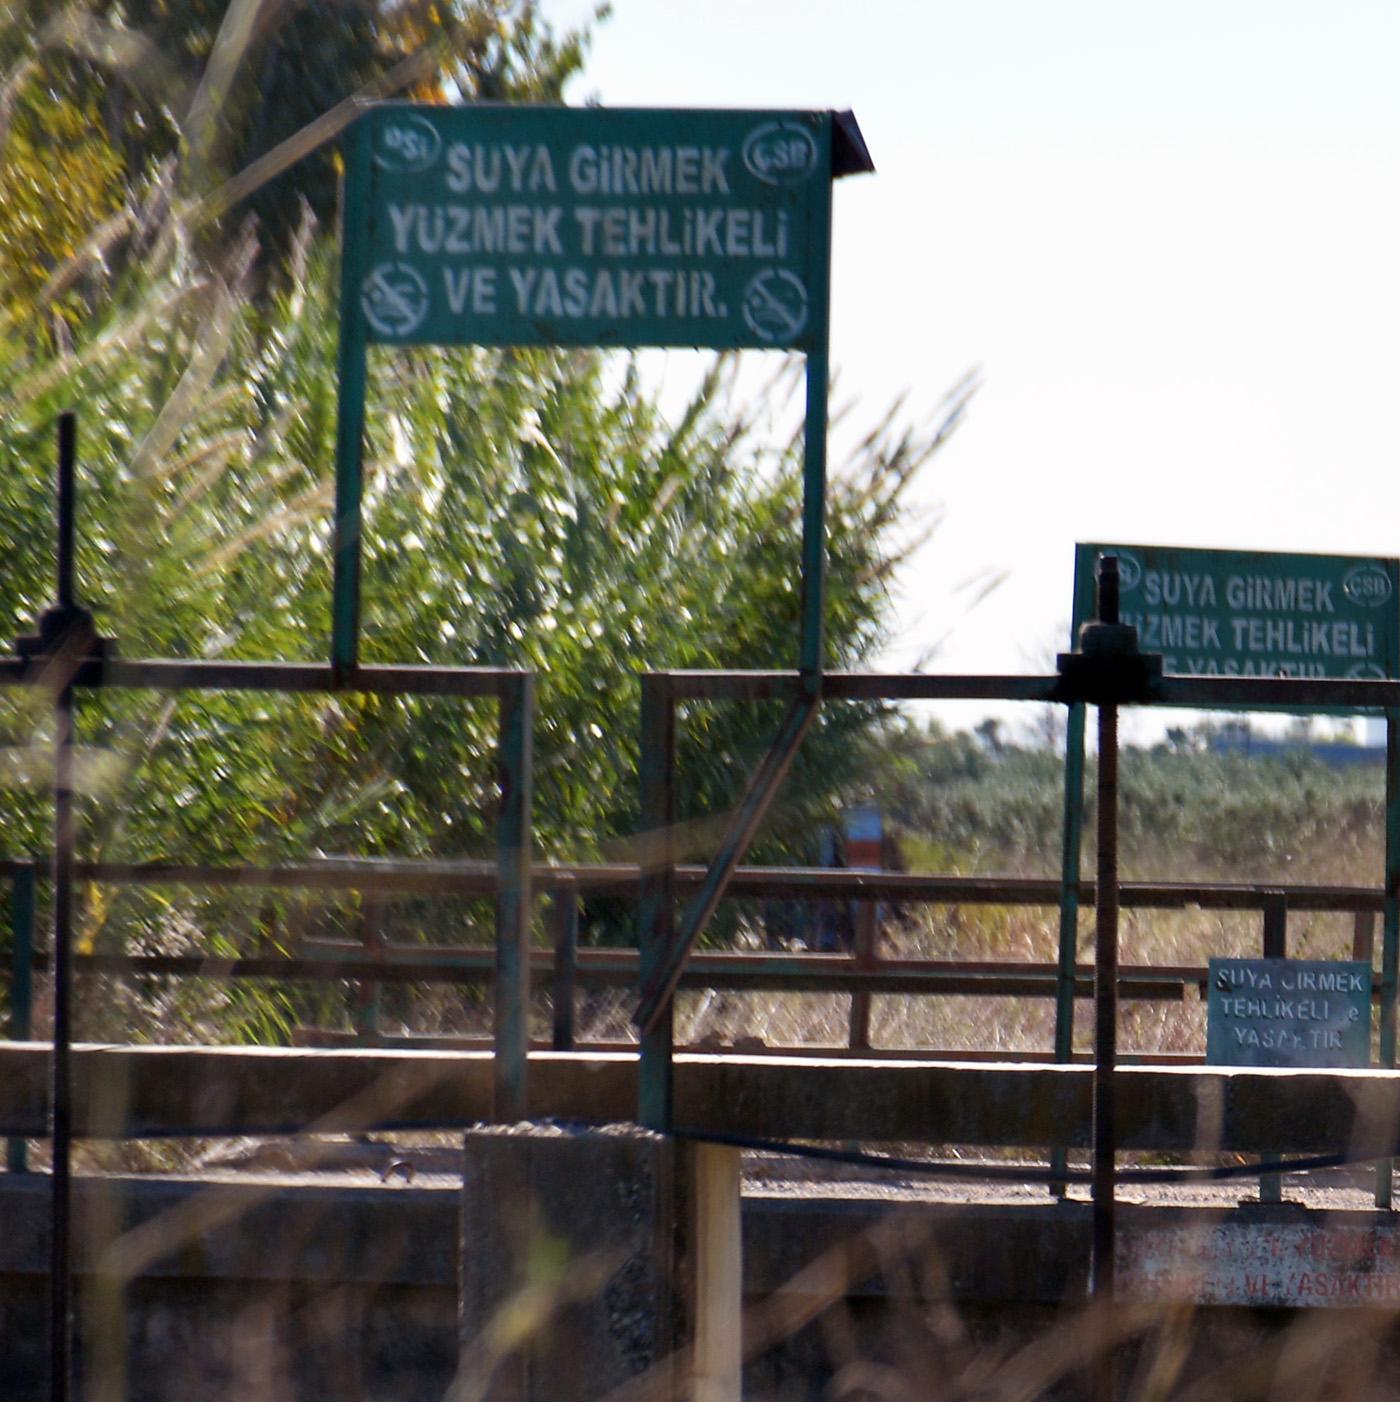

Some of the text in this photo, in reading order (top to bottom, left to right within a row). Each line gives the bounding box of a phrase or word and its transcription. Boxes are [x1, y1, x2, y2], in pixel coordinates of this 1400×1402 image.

[445, 143, 558, 192] SUYA
[443, 267, 728, 319] VE YASAKTIR.
[1144, 571, 1217, 606] SUYA
[1119, 613, 1221, 649] ZMEK
